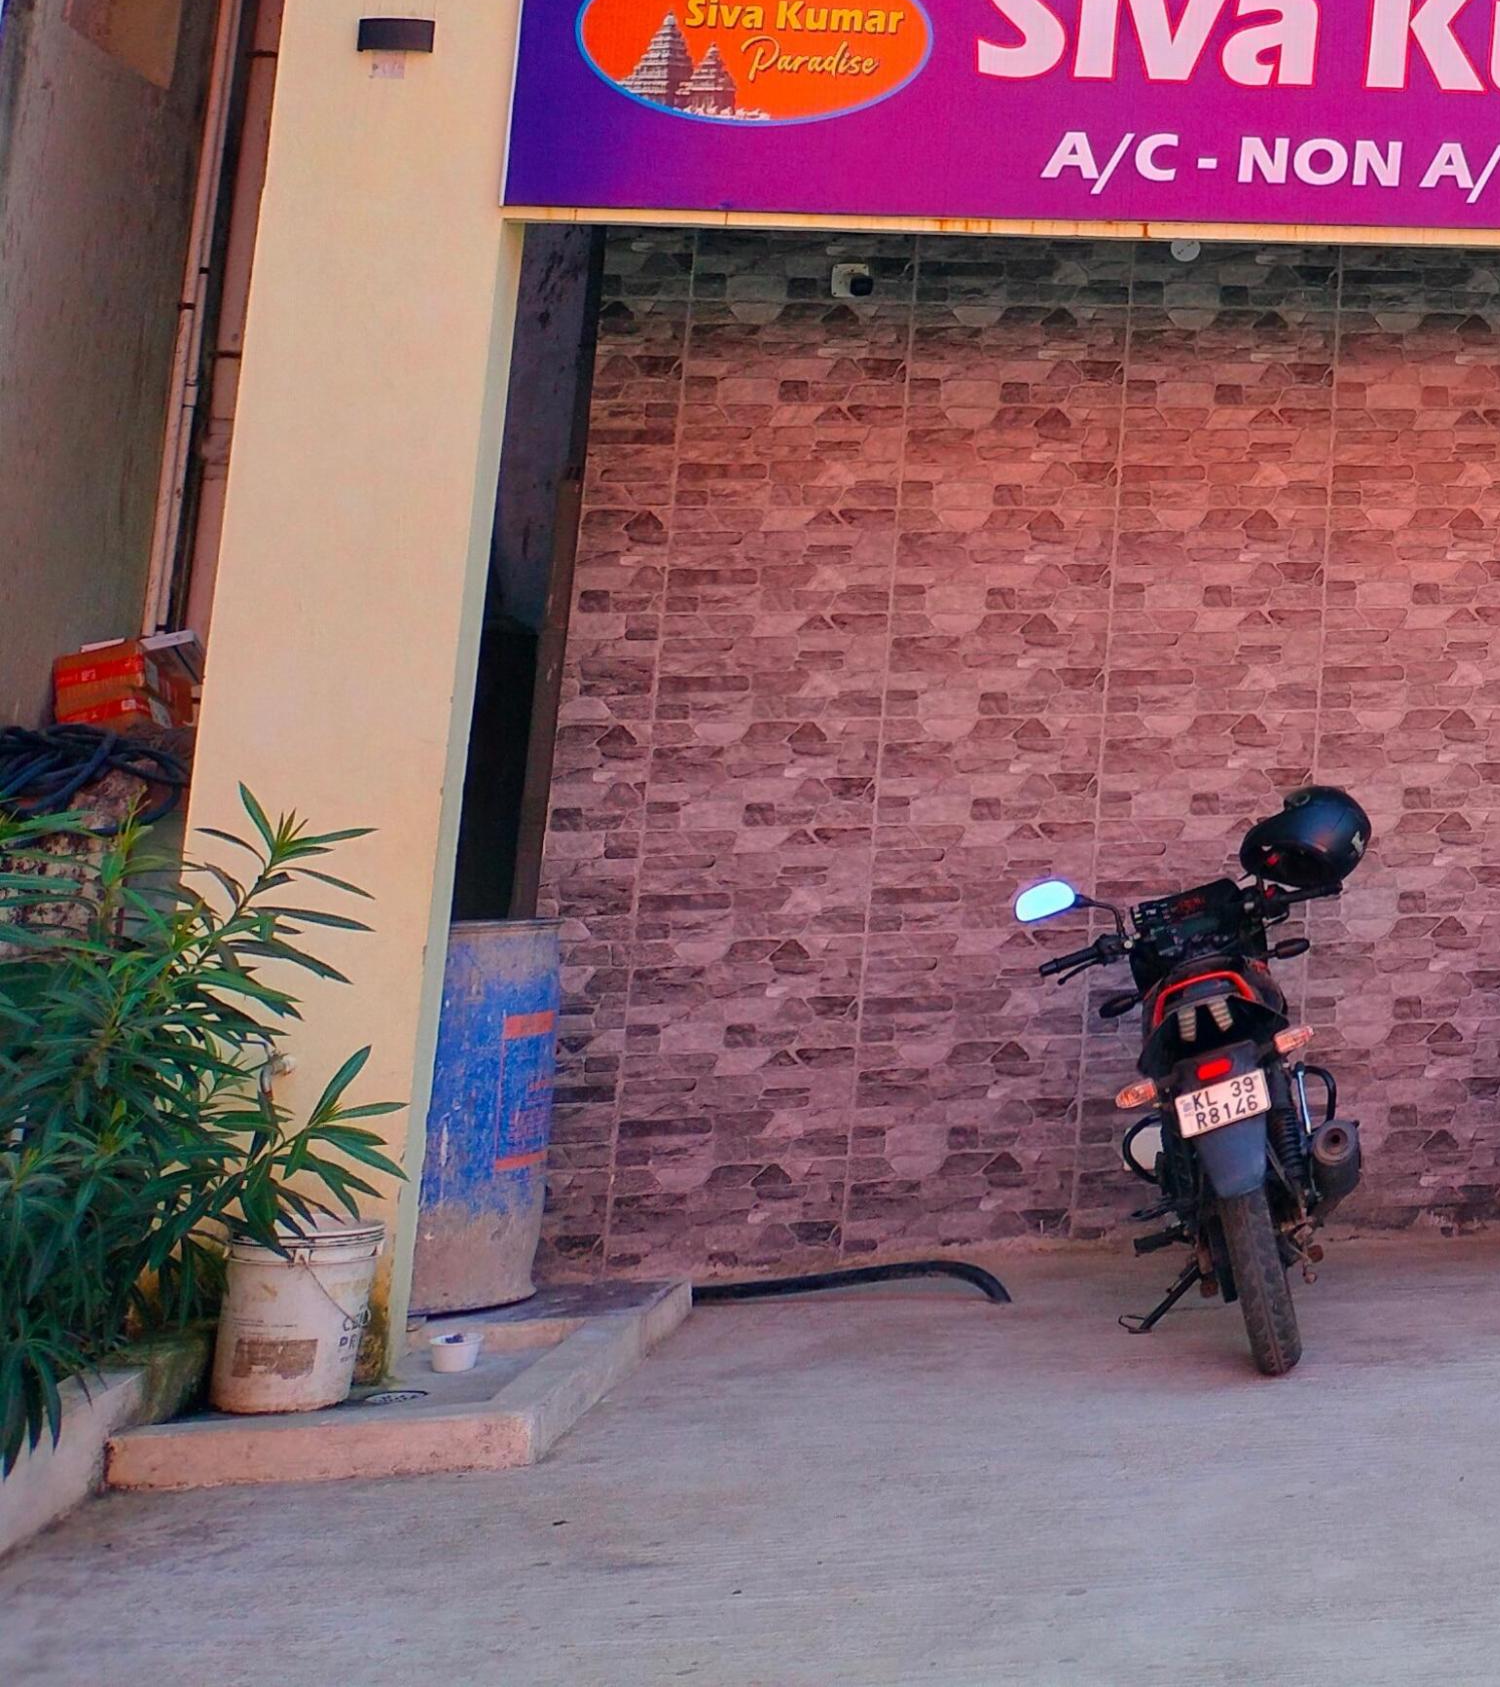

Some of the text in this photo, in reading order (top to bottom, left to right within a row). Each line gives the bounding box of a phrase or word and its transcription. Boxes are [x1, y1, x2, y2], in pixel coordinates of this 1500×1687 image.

[776, 0, 904, 34] Kumar
[740, 35, 879, 82] Paradise
[1041, 131, 1179, 194] A/C
[1238, 136, 1403, 187] NON
[1192, 1076, 1255, 1112] KL 39
[1195, 1094, 1258, 1130] R8146
